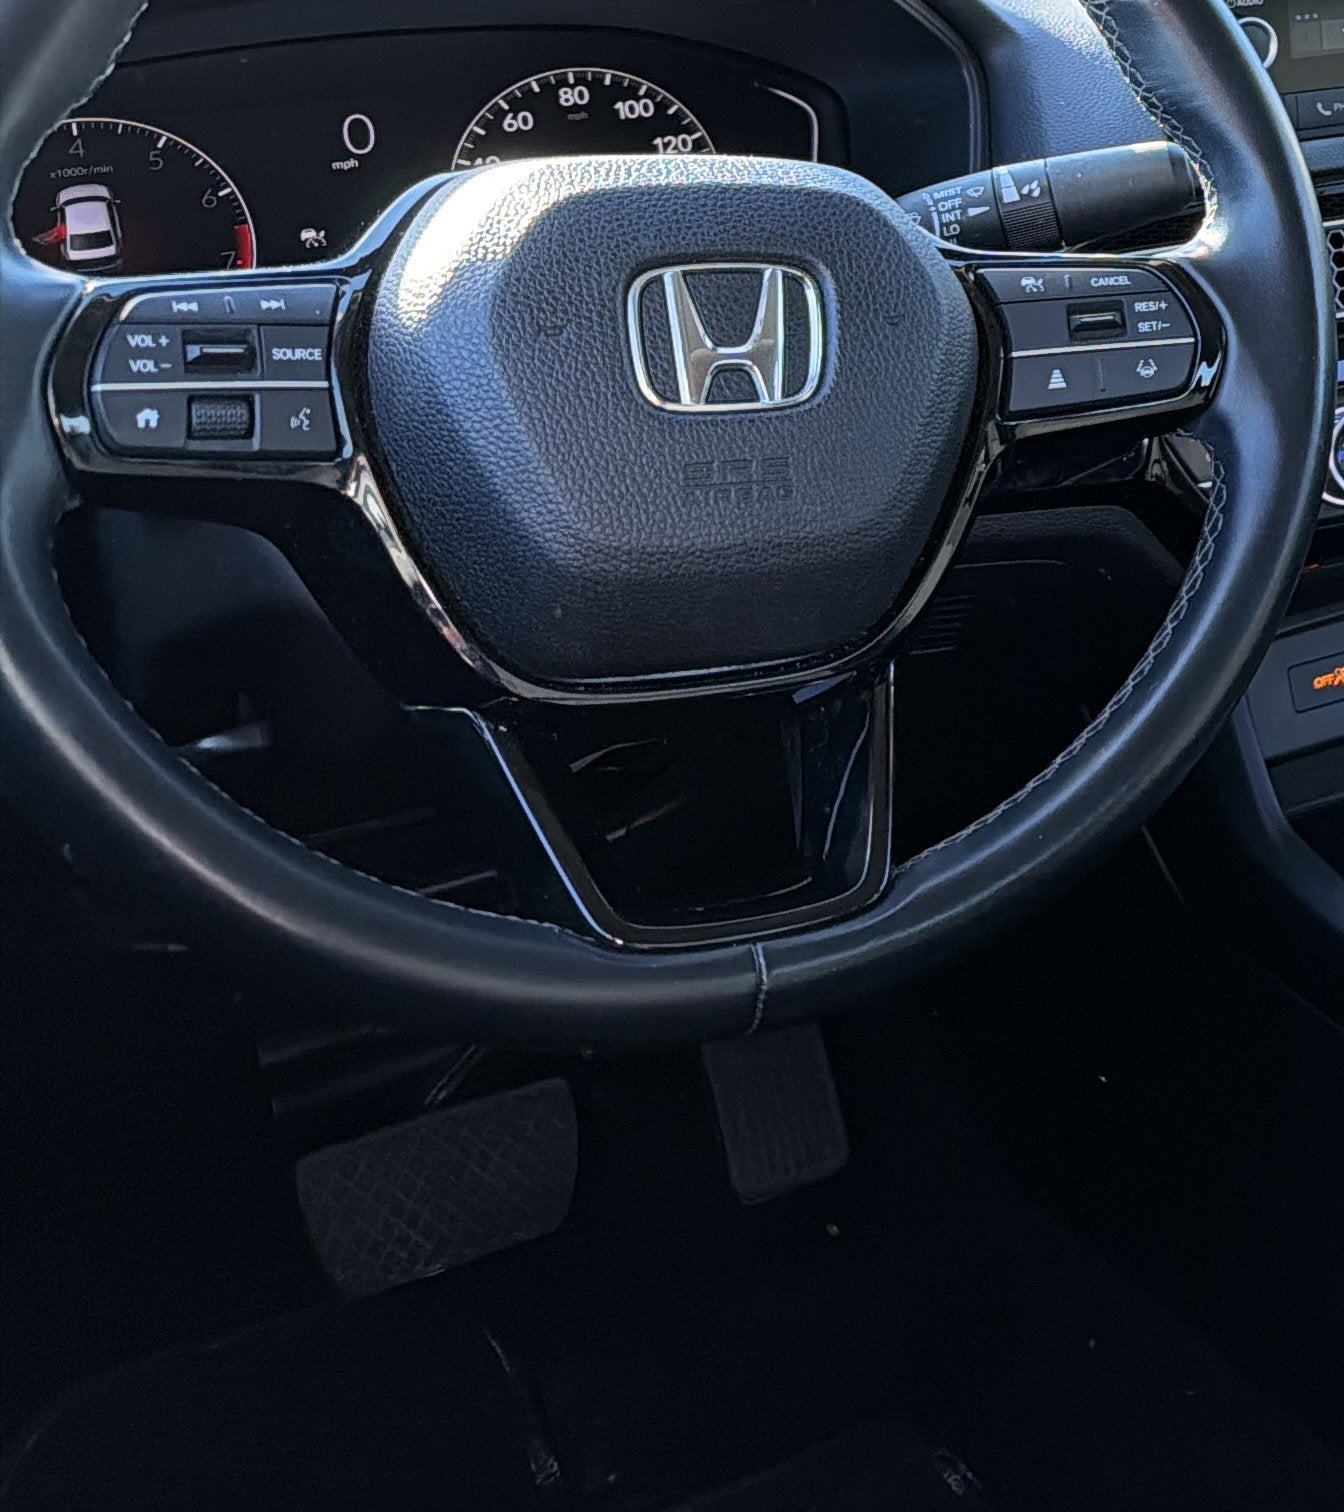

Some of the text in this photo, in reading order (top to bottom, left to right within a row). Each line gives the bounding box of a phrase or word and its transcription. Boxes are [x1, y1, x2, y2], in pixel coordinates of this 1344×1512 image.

[558, 86, 590, 107] 80
[567, 111, 589, 121] mph
[613, 99, 655, 120] 100
[502, 111, 534, 133] 60
[343, 114, 375, 154] 0
[68, 138, 86, 158] 4
[652, 134, 693, 155] 120
[149, 149, 164, 171] 5
[331, 158, 359, 171] mph
[50, 164, 114, 179] x1000r/min
[201, 188, 218, 209] 6
[932, 186, 963, 200] MIST
[938, 198, 963, 212] OFF
[941, 209, 963, 223] INT
[943, 223, 961, 237] LO
[220, 250, 237, 270] 7
[1090, 275, 1132, 287] CANCEL
[1134, 300, 1169, 313] RES/+
[127, 335, 156, 348] VOL
[272, 348, 323, 361] SOURCE
[129, 359, 158, 373] VOL
[1313, 673, 1335, 690] OFF
